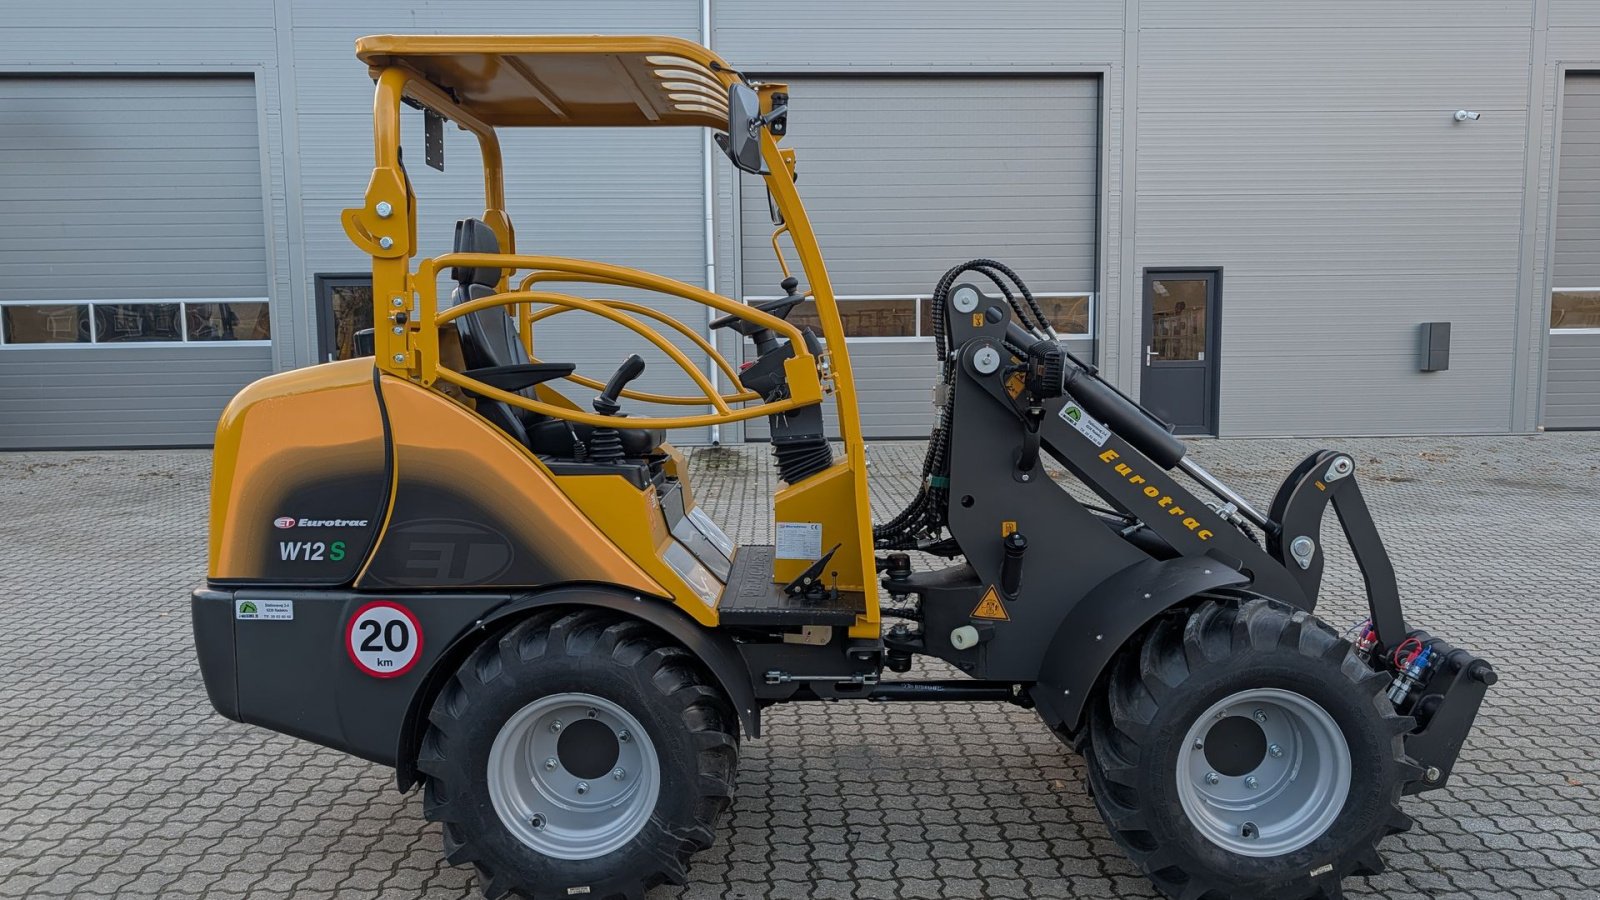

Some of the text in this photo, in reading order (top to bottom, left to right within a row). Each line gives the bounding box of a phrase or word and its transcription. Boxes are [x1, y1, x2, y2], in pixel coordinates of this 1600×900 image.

[1099, 449, 1213, 540] Eurotrac
[297, 518, 368, 527] Eurotrac
[279, 541, 346, 561] W12 S
[359, 619, 410, 653] 20
[377, 657, 393, 667] km
